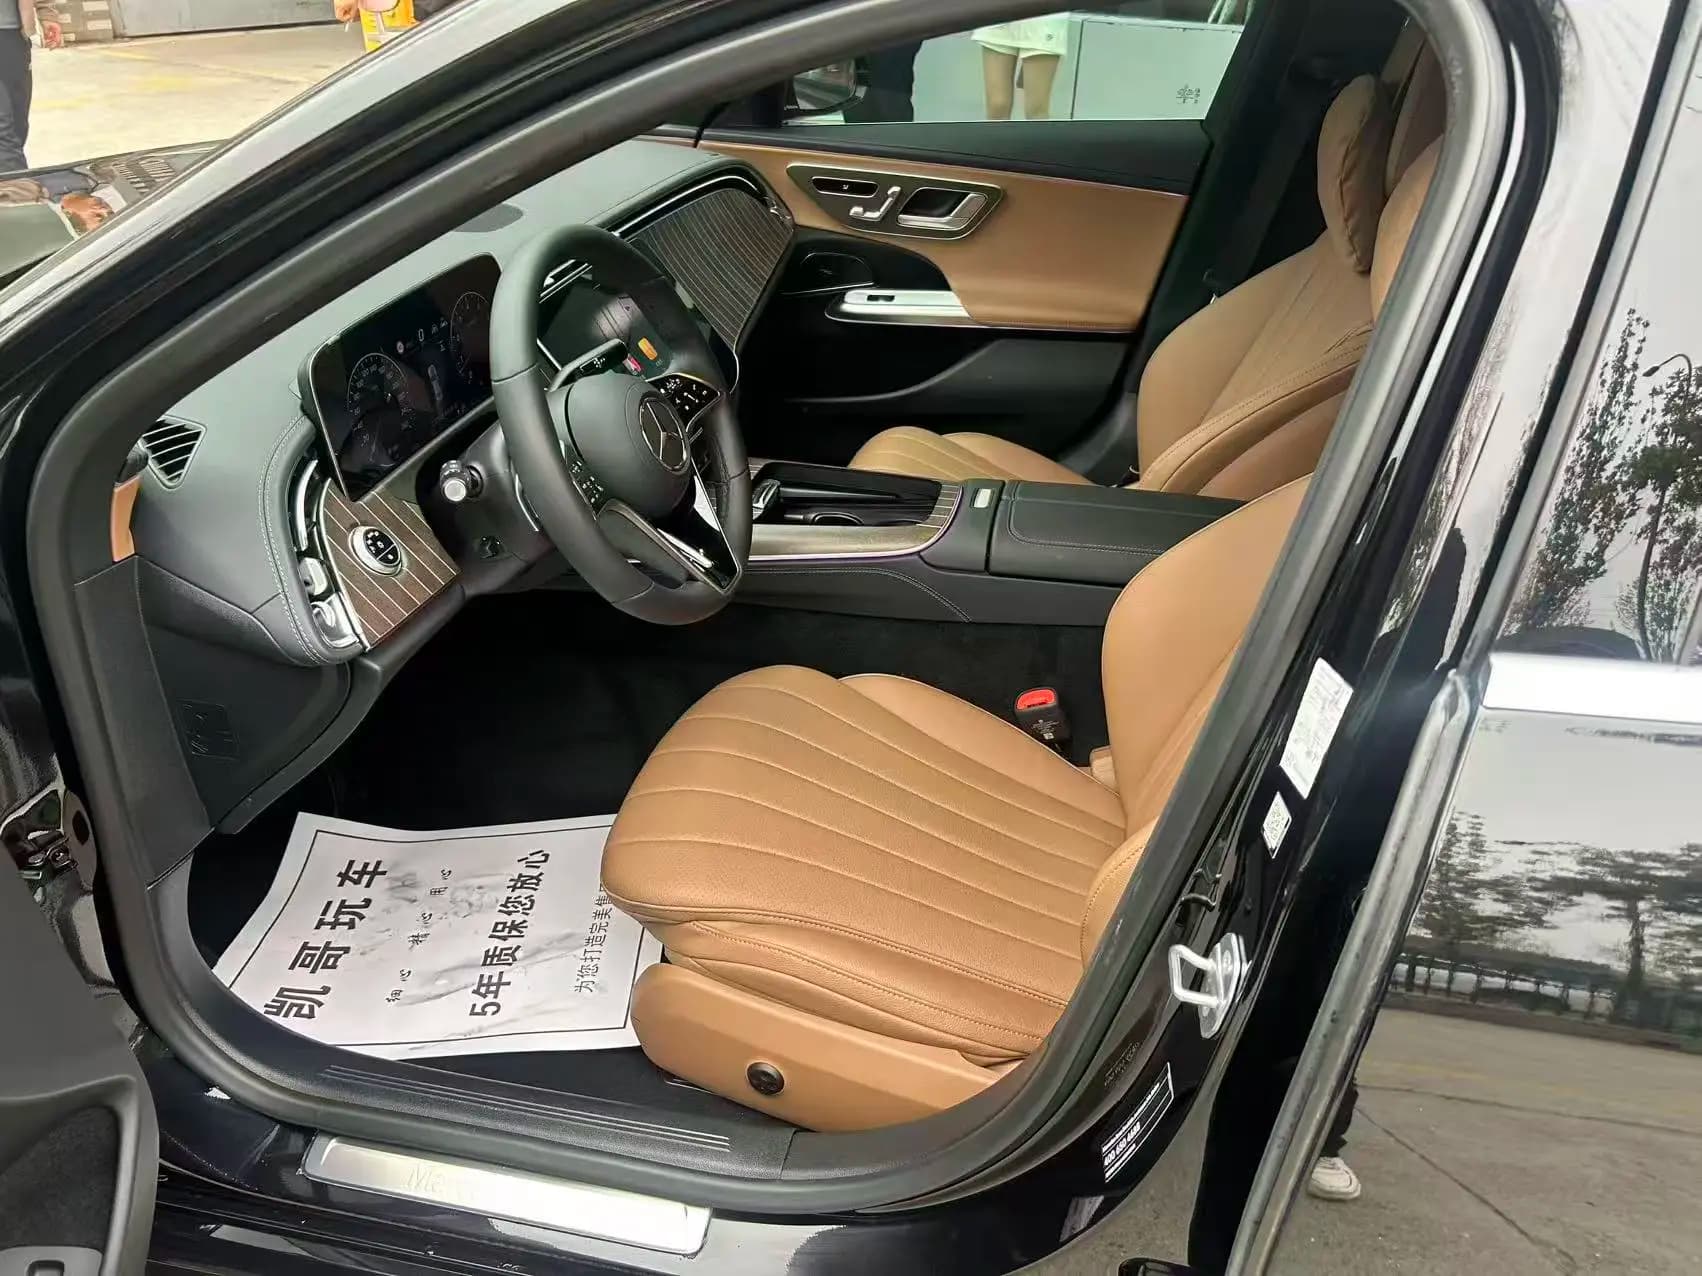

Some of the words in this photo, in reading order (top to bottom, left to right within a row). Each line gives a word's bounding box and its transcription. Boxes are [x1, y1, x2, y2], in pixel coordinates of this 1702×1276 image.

[264, 859, 387, 1020] 凯哥玩车
[385, 969, 412, 1003] 细心
[430, 869, 452, 896] 用心
[469, 848, 550, 1017] 5年质保您放心
[574, 883, 613, 993] 为您打造完美售
